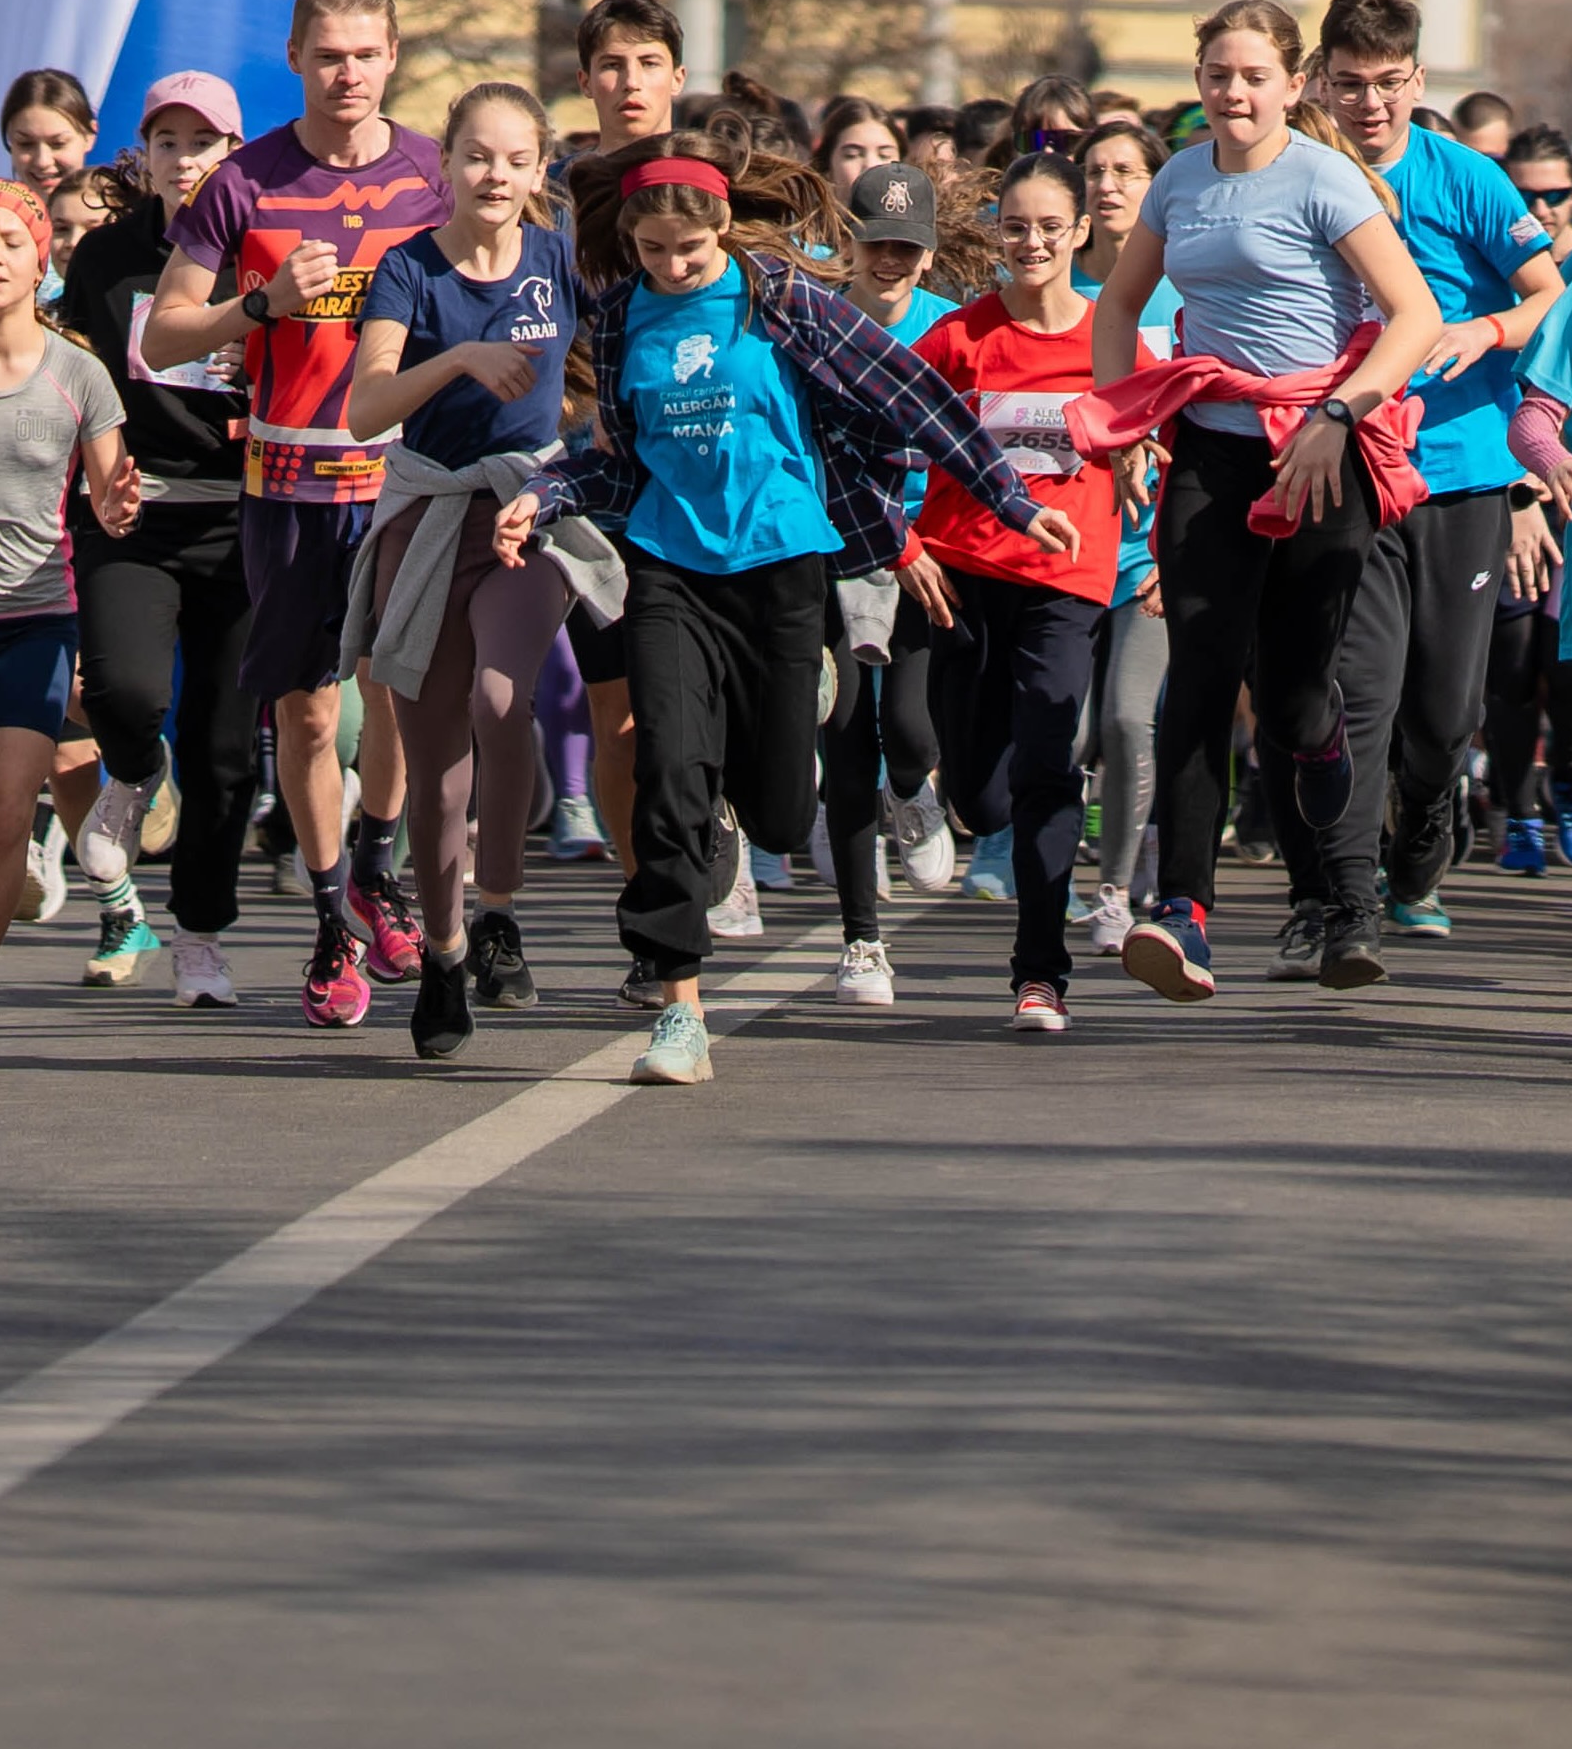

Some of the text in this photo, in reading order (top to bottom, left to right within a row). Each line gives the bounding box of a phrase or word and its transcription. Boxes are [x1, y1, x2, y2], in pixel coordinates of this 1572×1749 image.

[510, 322, 558, 342] SARAH
[663, 395, 736, 416] ALERGĂM
[1033, 408, 1062, 418] ALER
[672, 421, 735, 439] MAMA
[1033, 418, 1065, 426] MAM
[1003, 432, 1075, 452] 2655
